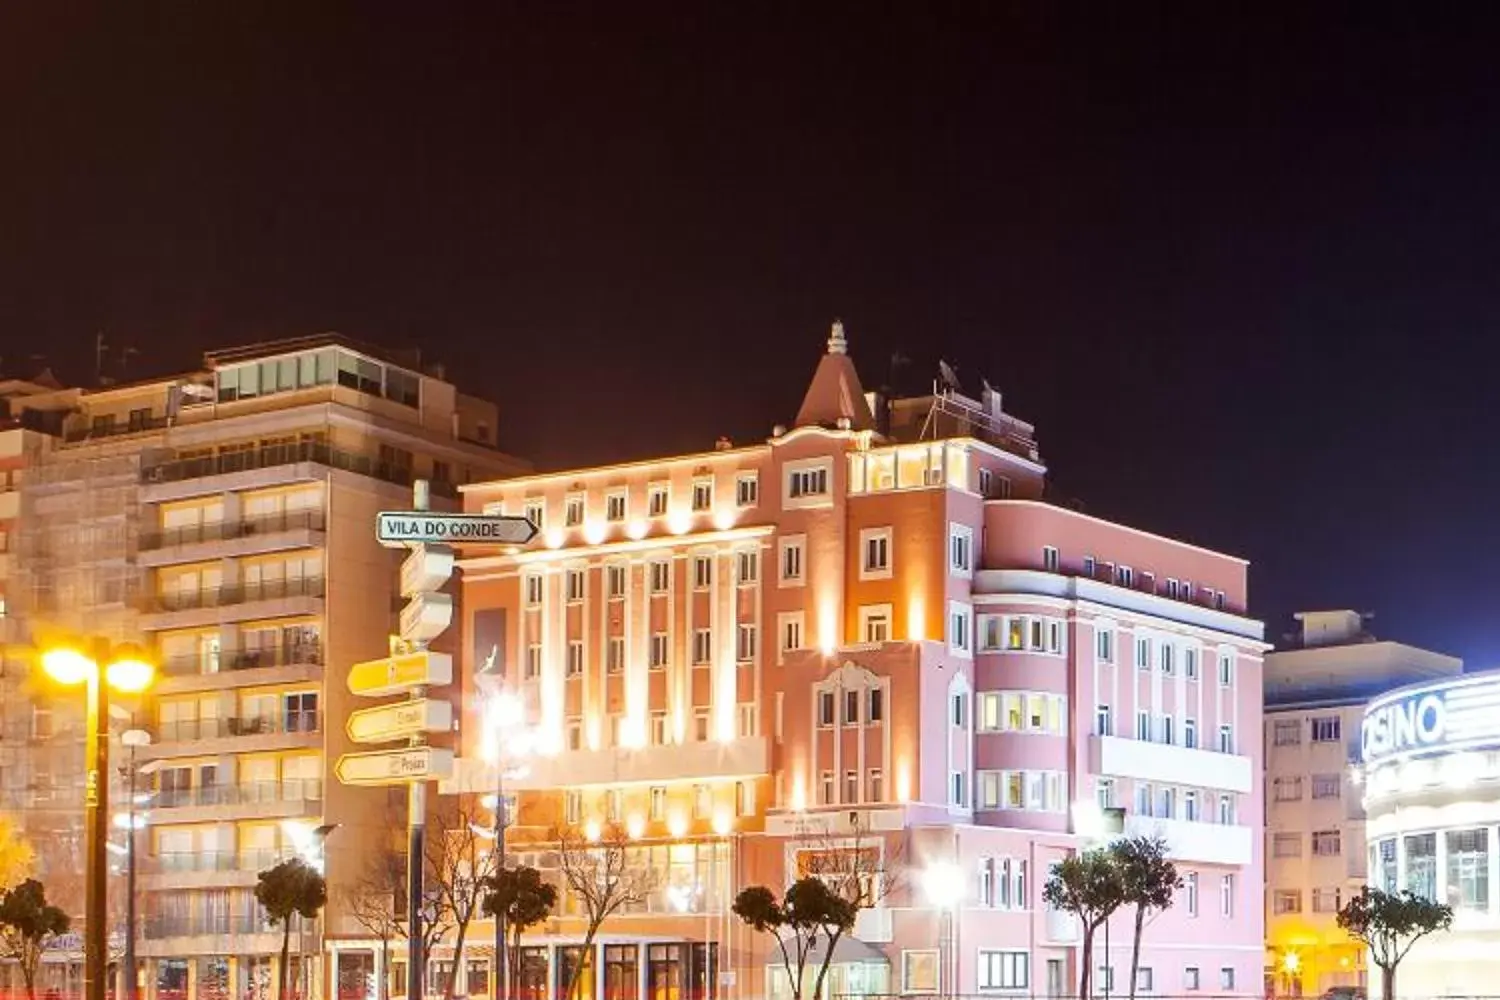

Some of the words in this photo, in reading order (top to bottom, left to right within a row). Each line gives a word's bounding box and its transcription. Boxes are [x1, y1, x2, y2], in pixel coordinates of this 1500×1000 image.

[387, 521, 419, 535] VILA
[425, 522, 446, 535] DO
[450, 523, 500, 536] CONDE
